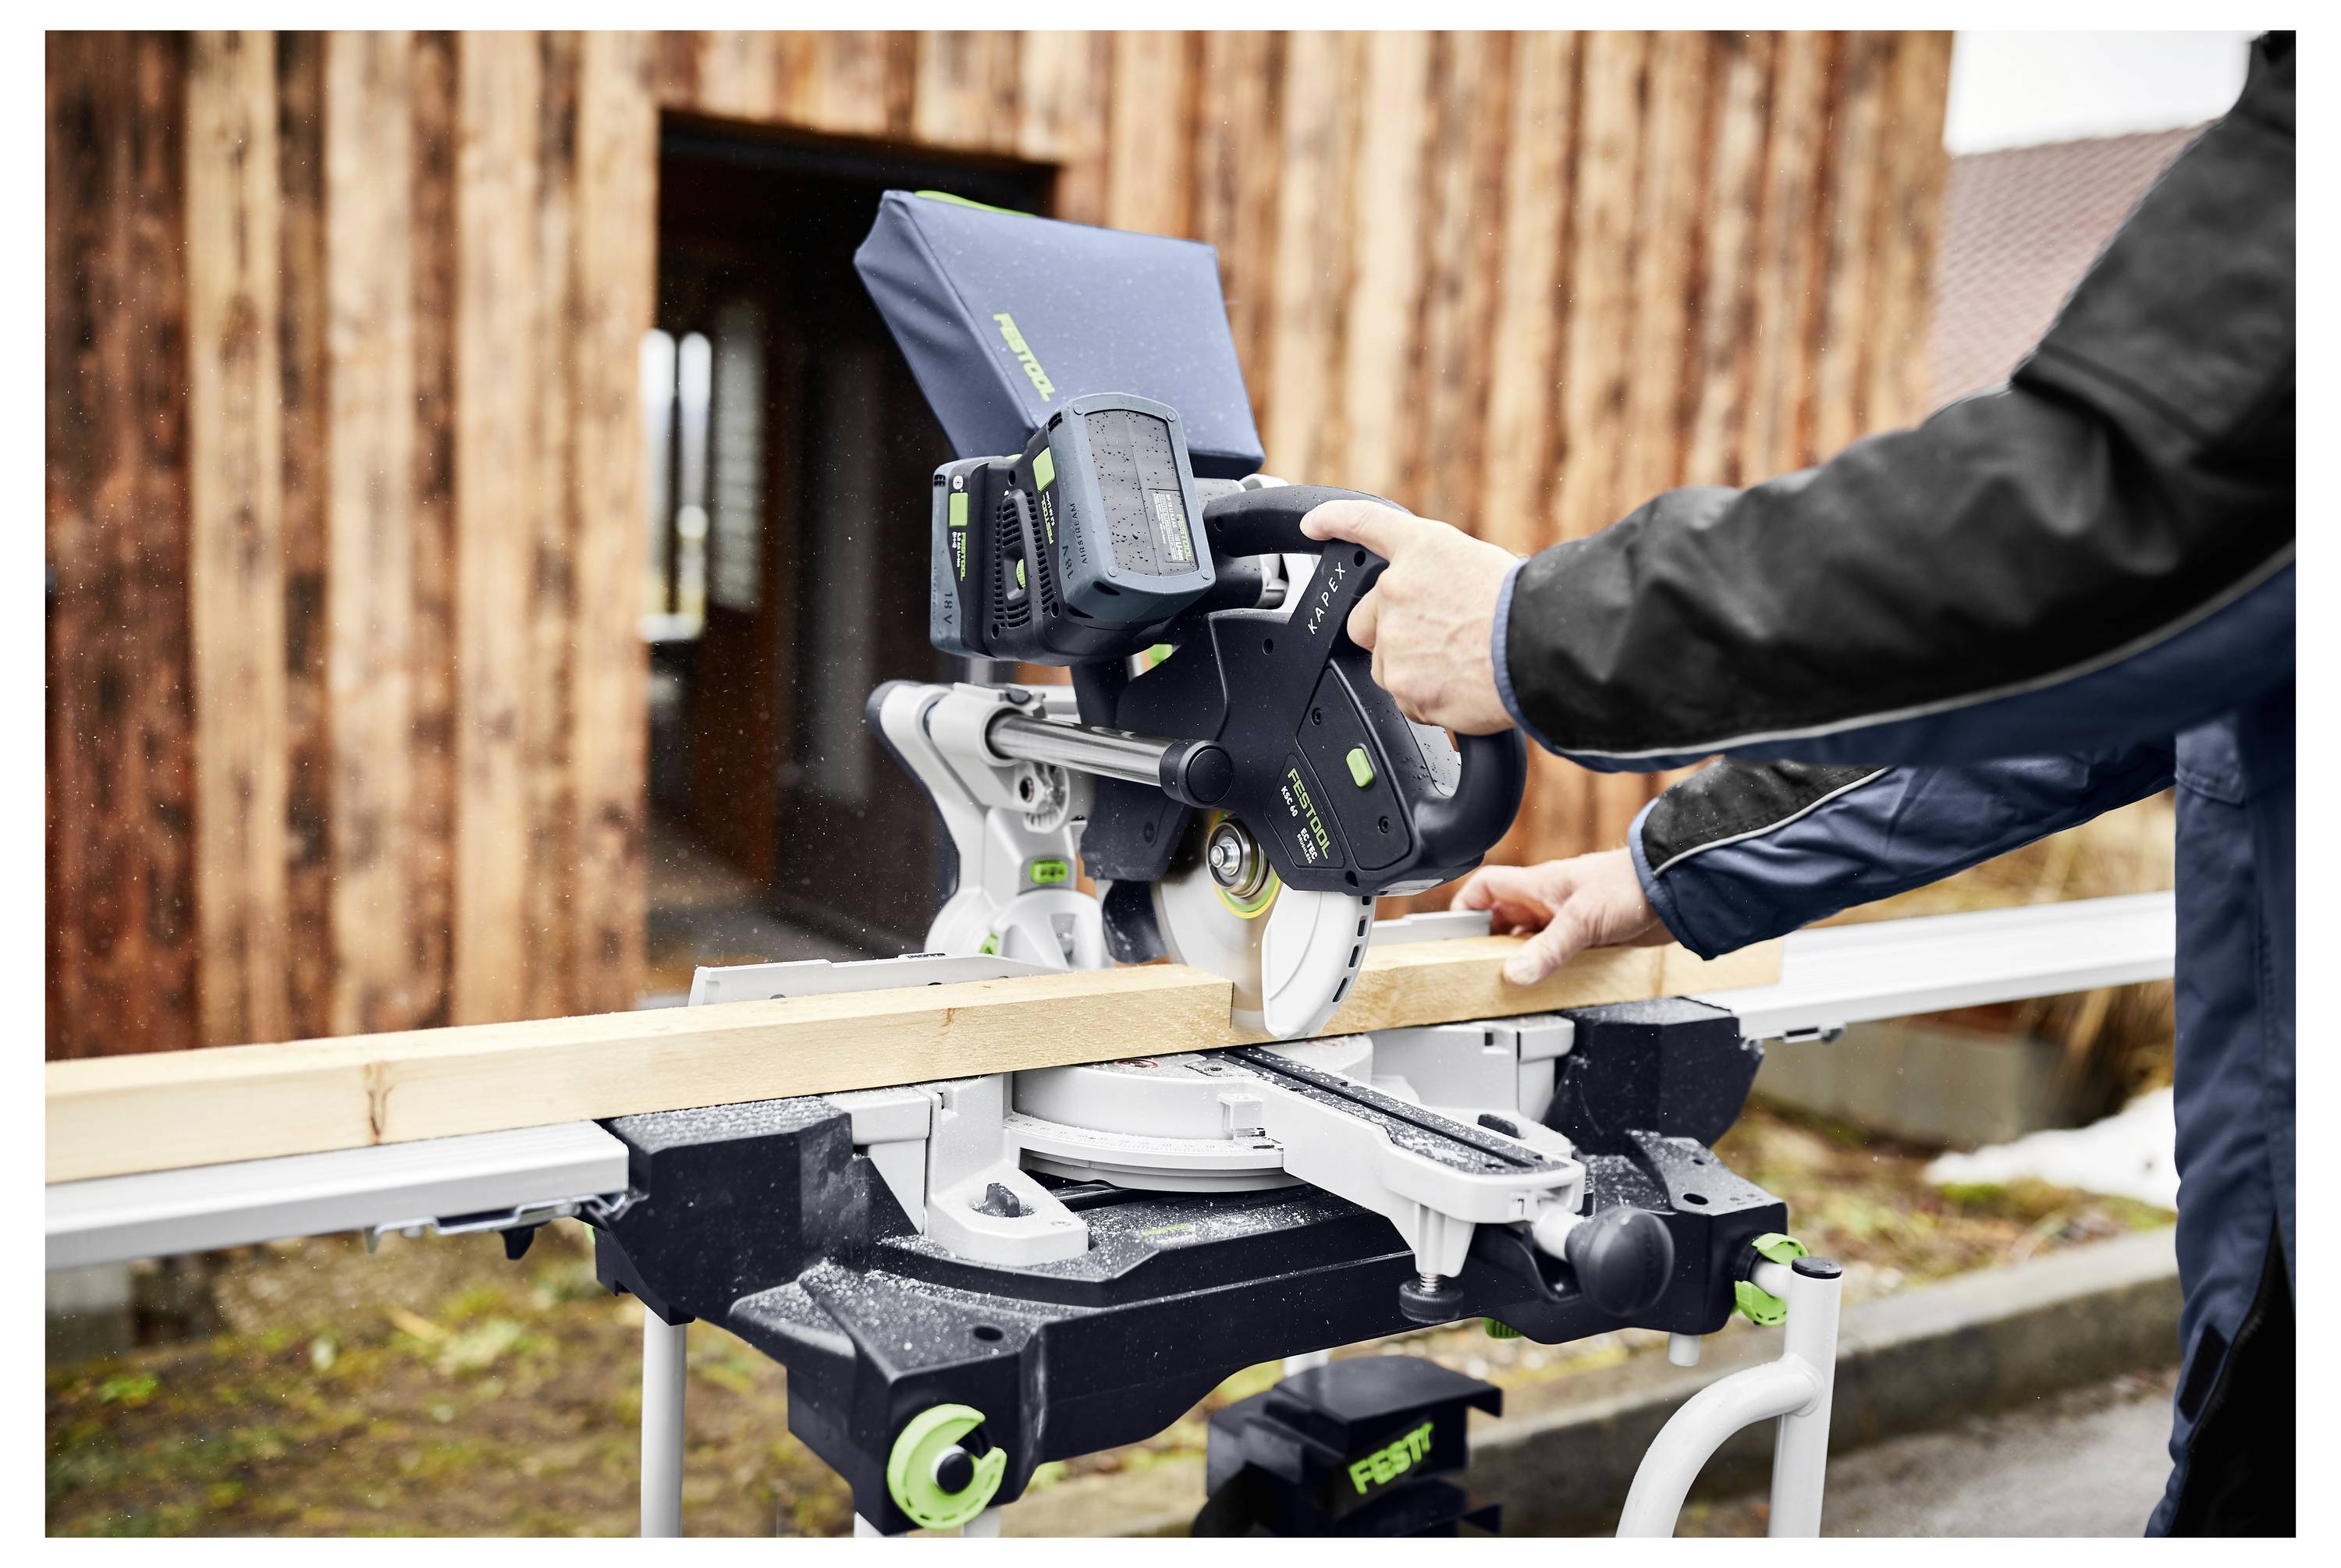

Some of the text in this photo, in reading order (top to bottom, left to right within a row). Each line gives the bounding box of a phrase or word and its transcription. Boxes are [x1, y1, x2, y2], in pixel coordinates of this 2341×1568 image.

[993, 312, 1056, 403] FESTOOL
[1041, 494, 1054, 545] FESTOOL
[1070, 502, 1088, 565] AIRSTREAM
[1177, 513, 1192, 561] FESTOOL
[1062, 545, 1074, 580] 18 V
[943, 591, 953, 625] 18 V
[1307, 561, 1346, 635] KAPEX
[1281, 786, 1298, 818] KSC 60
[1287, 768, 1330, 860] FESTOOL
[1297, 833, 1313, 864] BRUSHLESS
[1300, 827, 1318, 860] EC TEC
